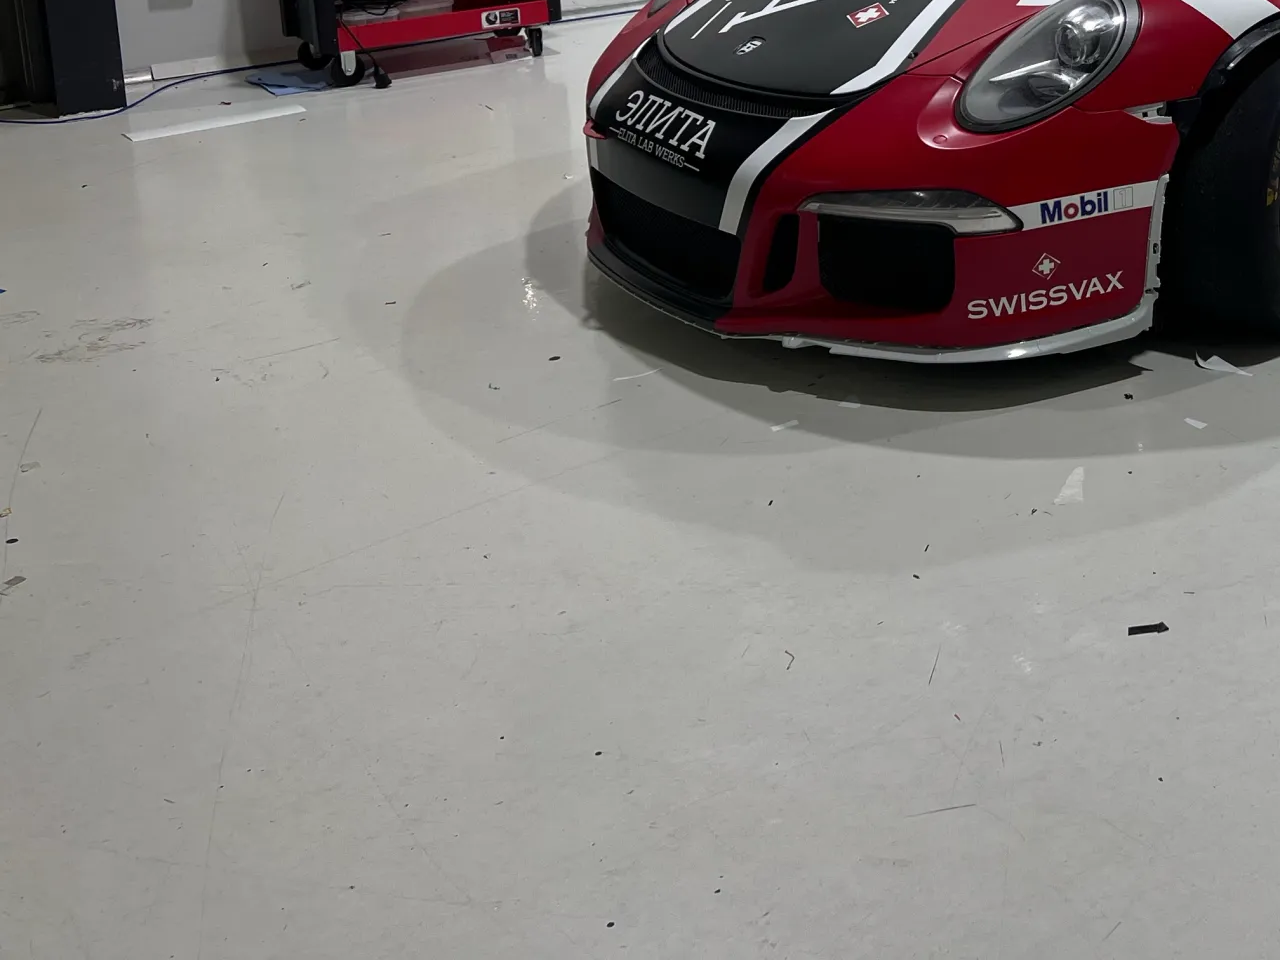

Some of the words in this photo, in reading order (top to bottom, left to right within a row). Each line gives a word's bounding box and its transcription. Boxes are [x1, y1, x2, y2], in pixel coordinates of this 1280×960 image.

[615, 90, 716, 159] ЭЛИТА
[617, 128, 637, 146] ELITA
[637, 138, 654, 153] LAB
[655, 144, 685, 168] WERKS
[1040, 191, 1108, 224] Mobil
[967, 270, 1124, 319] SWISSVAX
